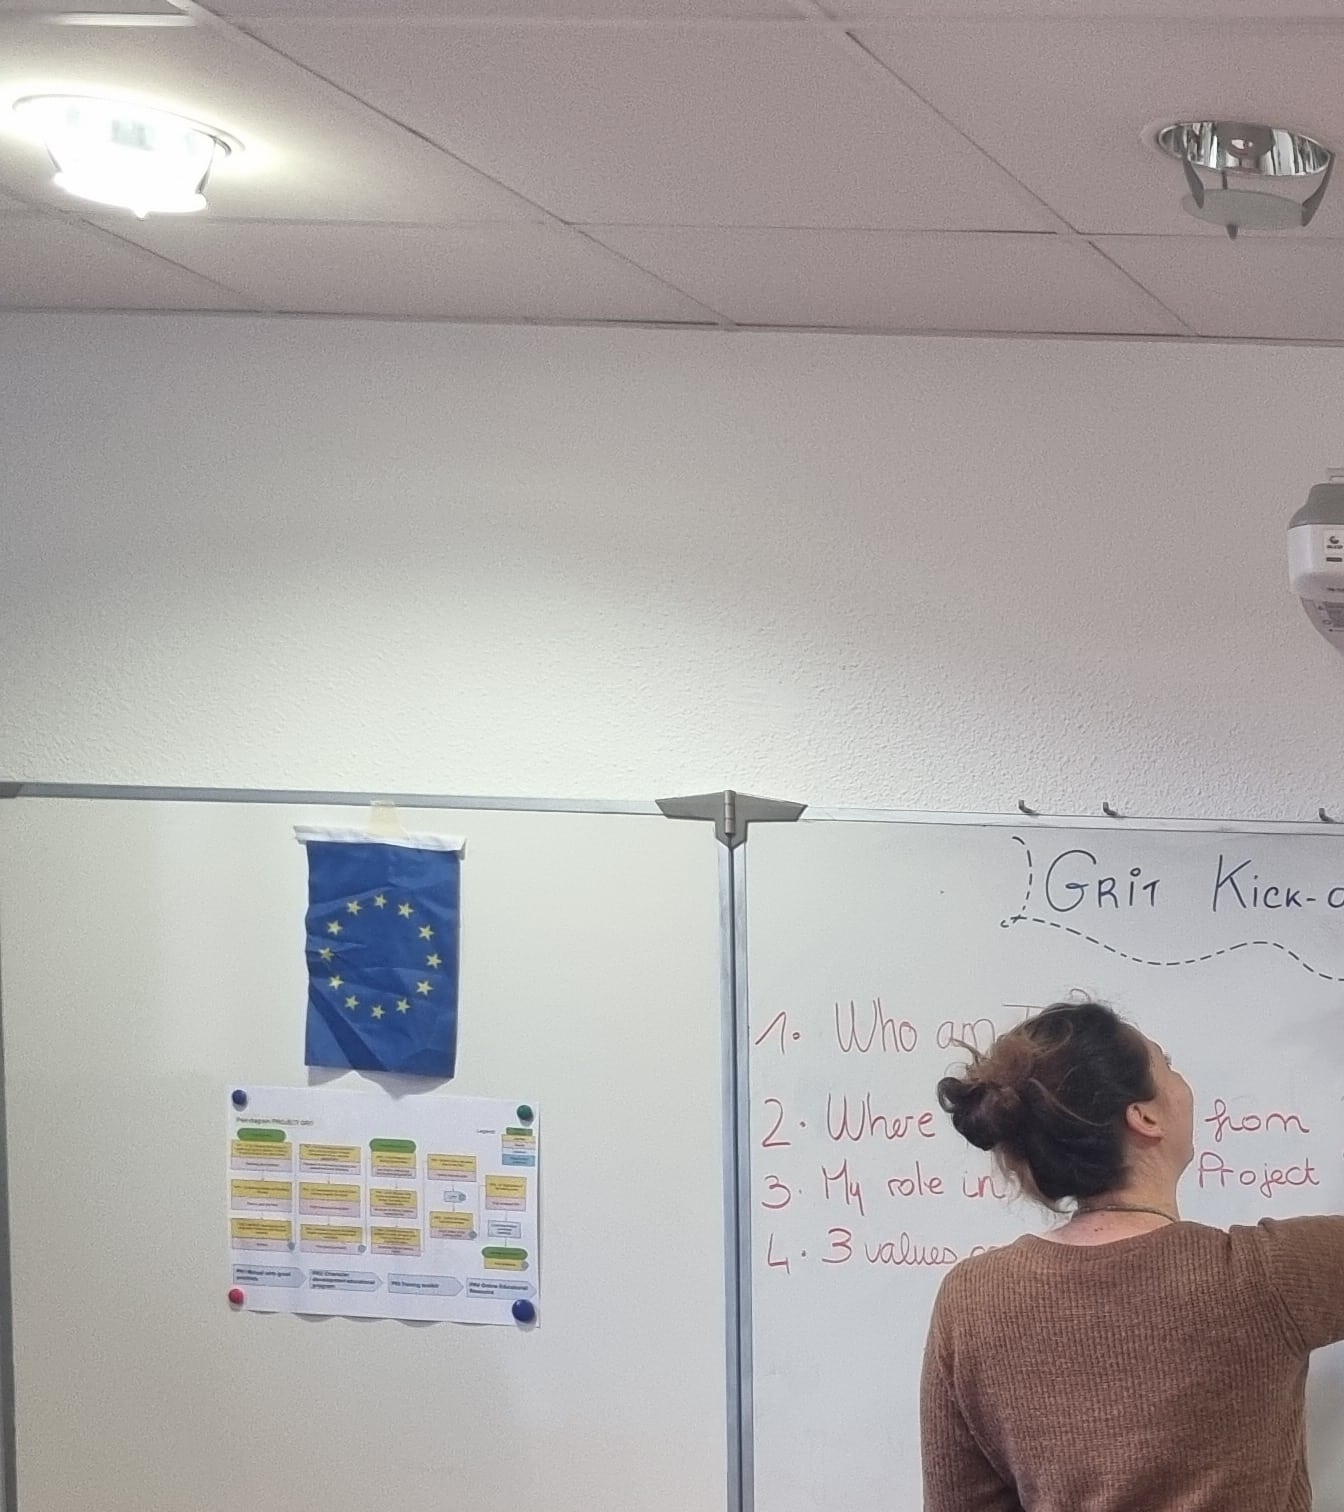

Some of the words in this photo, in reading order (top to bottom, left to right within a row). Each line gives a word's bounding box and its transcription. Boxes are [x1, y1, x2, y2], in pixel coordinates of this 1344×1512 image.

[835, 997, 919, 1053] Who
[826, 1092, 937, 1141] Where
[1204, 1098, 1311, 1143] from
[821, 1157, 866, 1217] My
[886, 1159, 945, 1198] role
[1198, 1151, 1321, 1199] Project
[821, 1226, 853, 1264] 3
[863, 1231, 959, 1266] values
